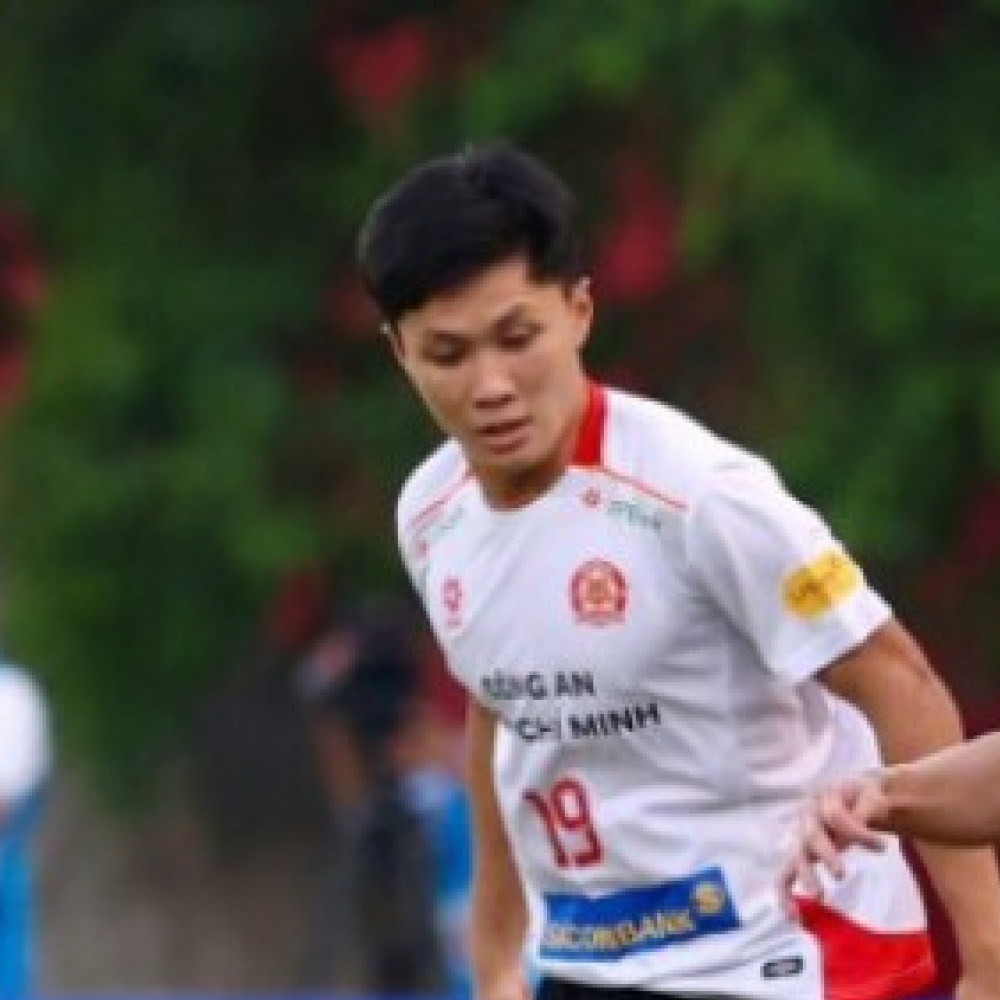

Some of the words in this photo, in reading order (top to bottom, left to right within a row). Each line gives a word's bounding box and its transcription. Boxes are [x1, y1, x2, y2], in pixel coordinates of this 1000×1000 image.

[554, 671, 595, 696] AN
[569, 703, 660, 739] MINH
[522, 777, 604, 868] 19
